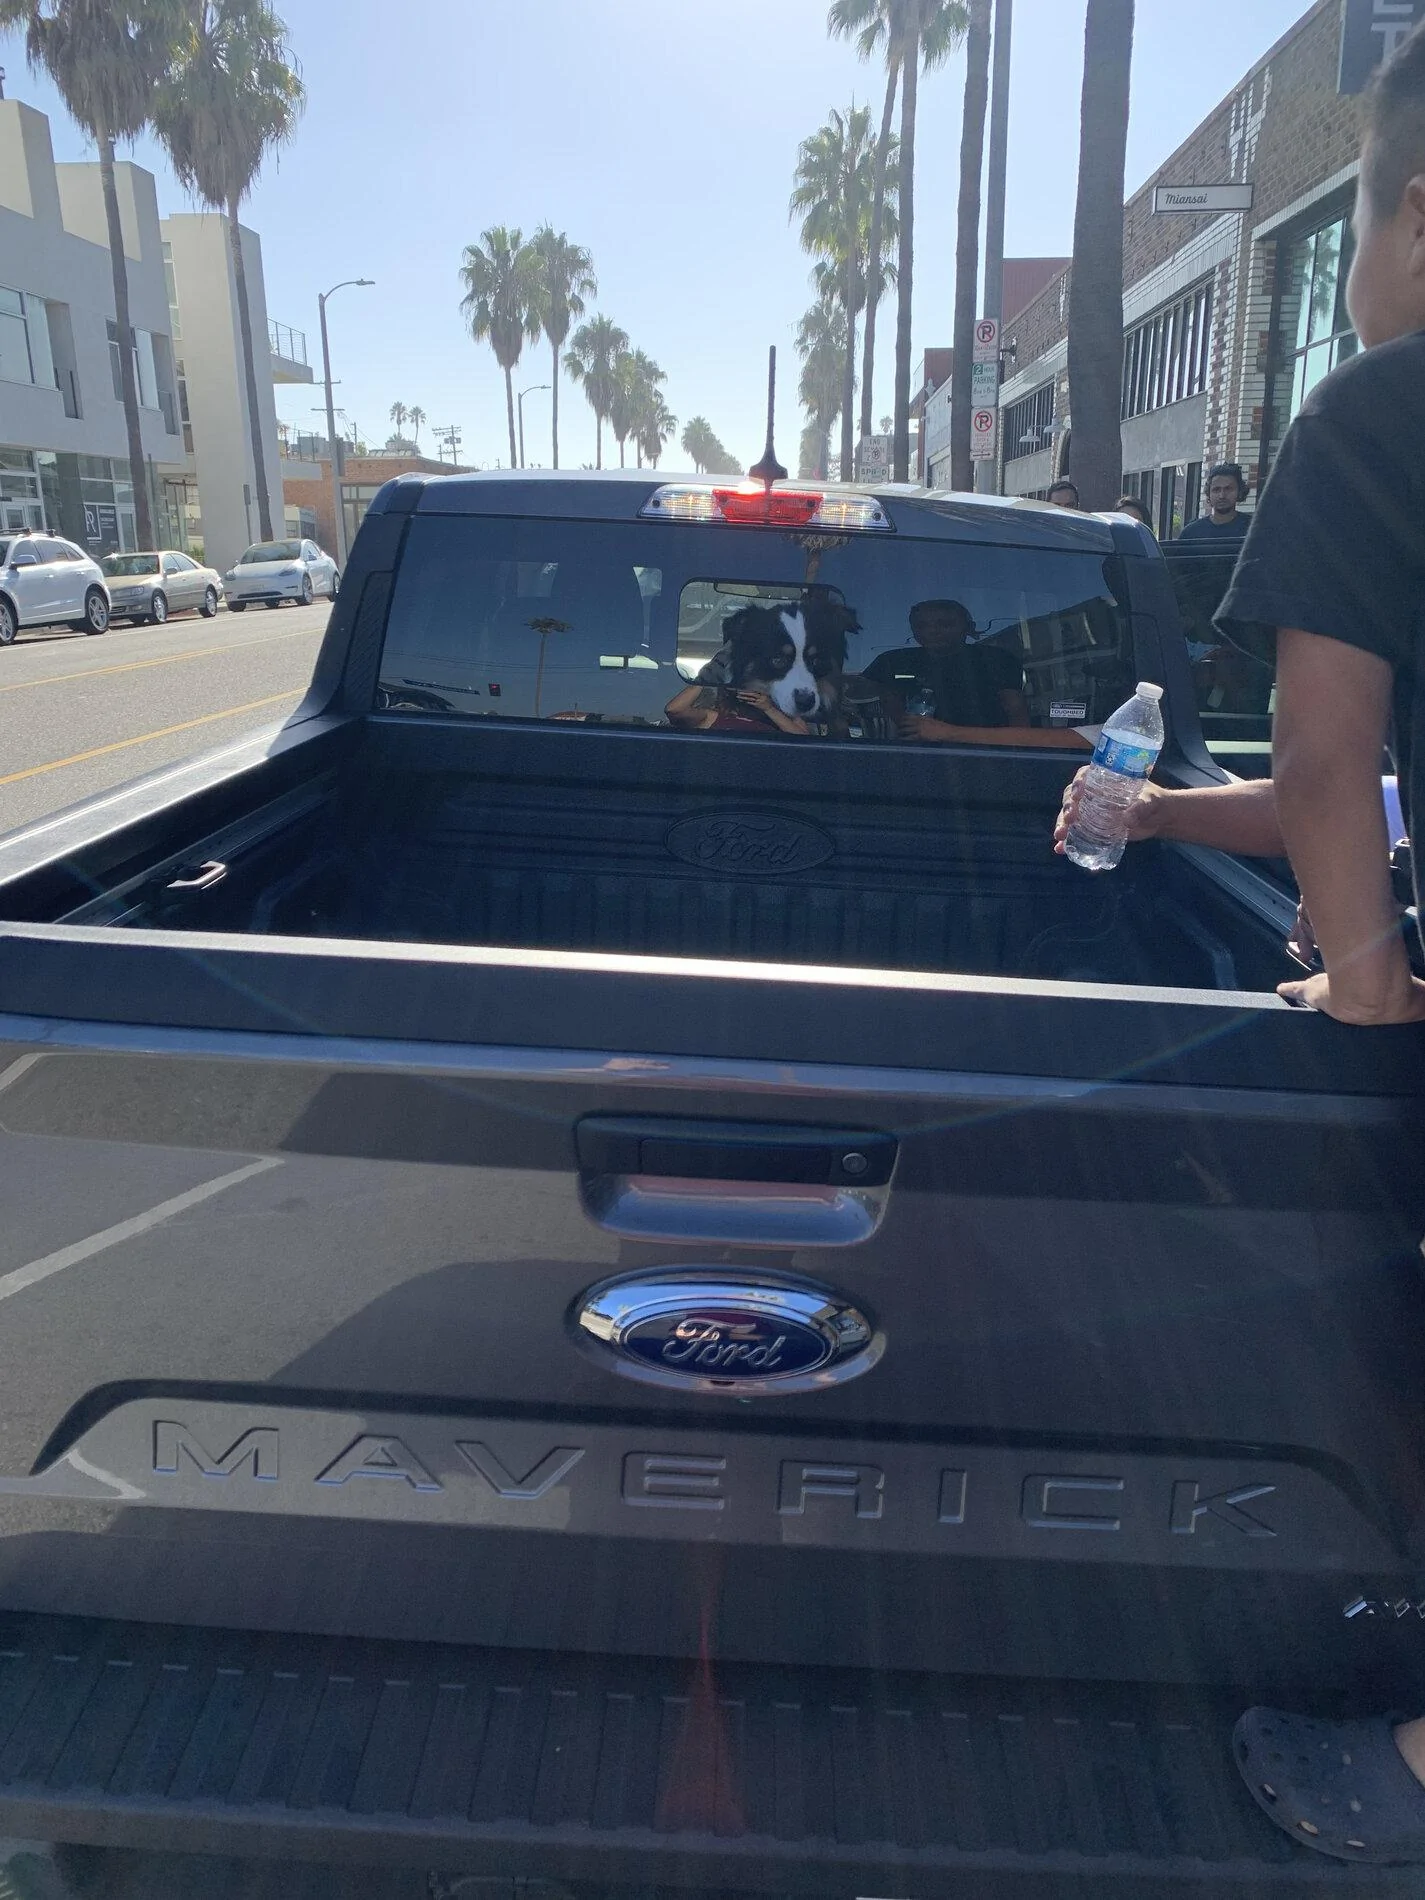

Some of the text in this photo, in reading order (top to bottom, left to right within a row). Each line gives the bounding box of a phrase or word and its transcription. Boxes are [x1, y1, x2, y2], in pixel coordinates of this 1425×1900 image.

[1164, 193, 1208, 204] Miansai
[695, 819, 802, 865] Ford
[661, 1315, 787, 1369] Ford
[151, 1418, 1278, 1538] MAVERICK
